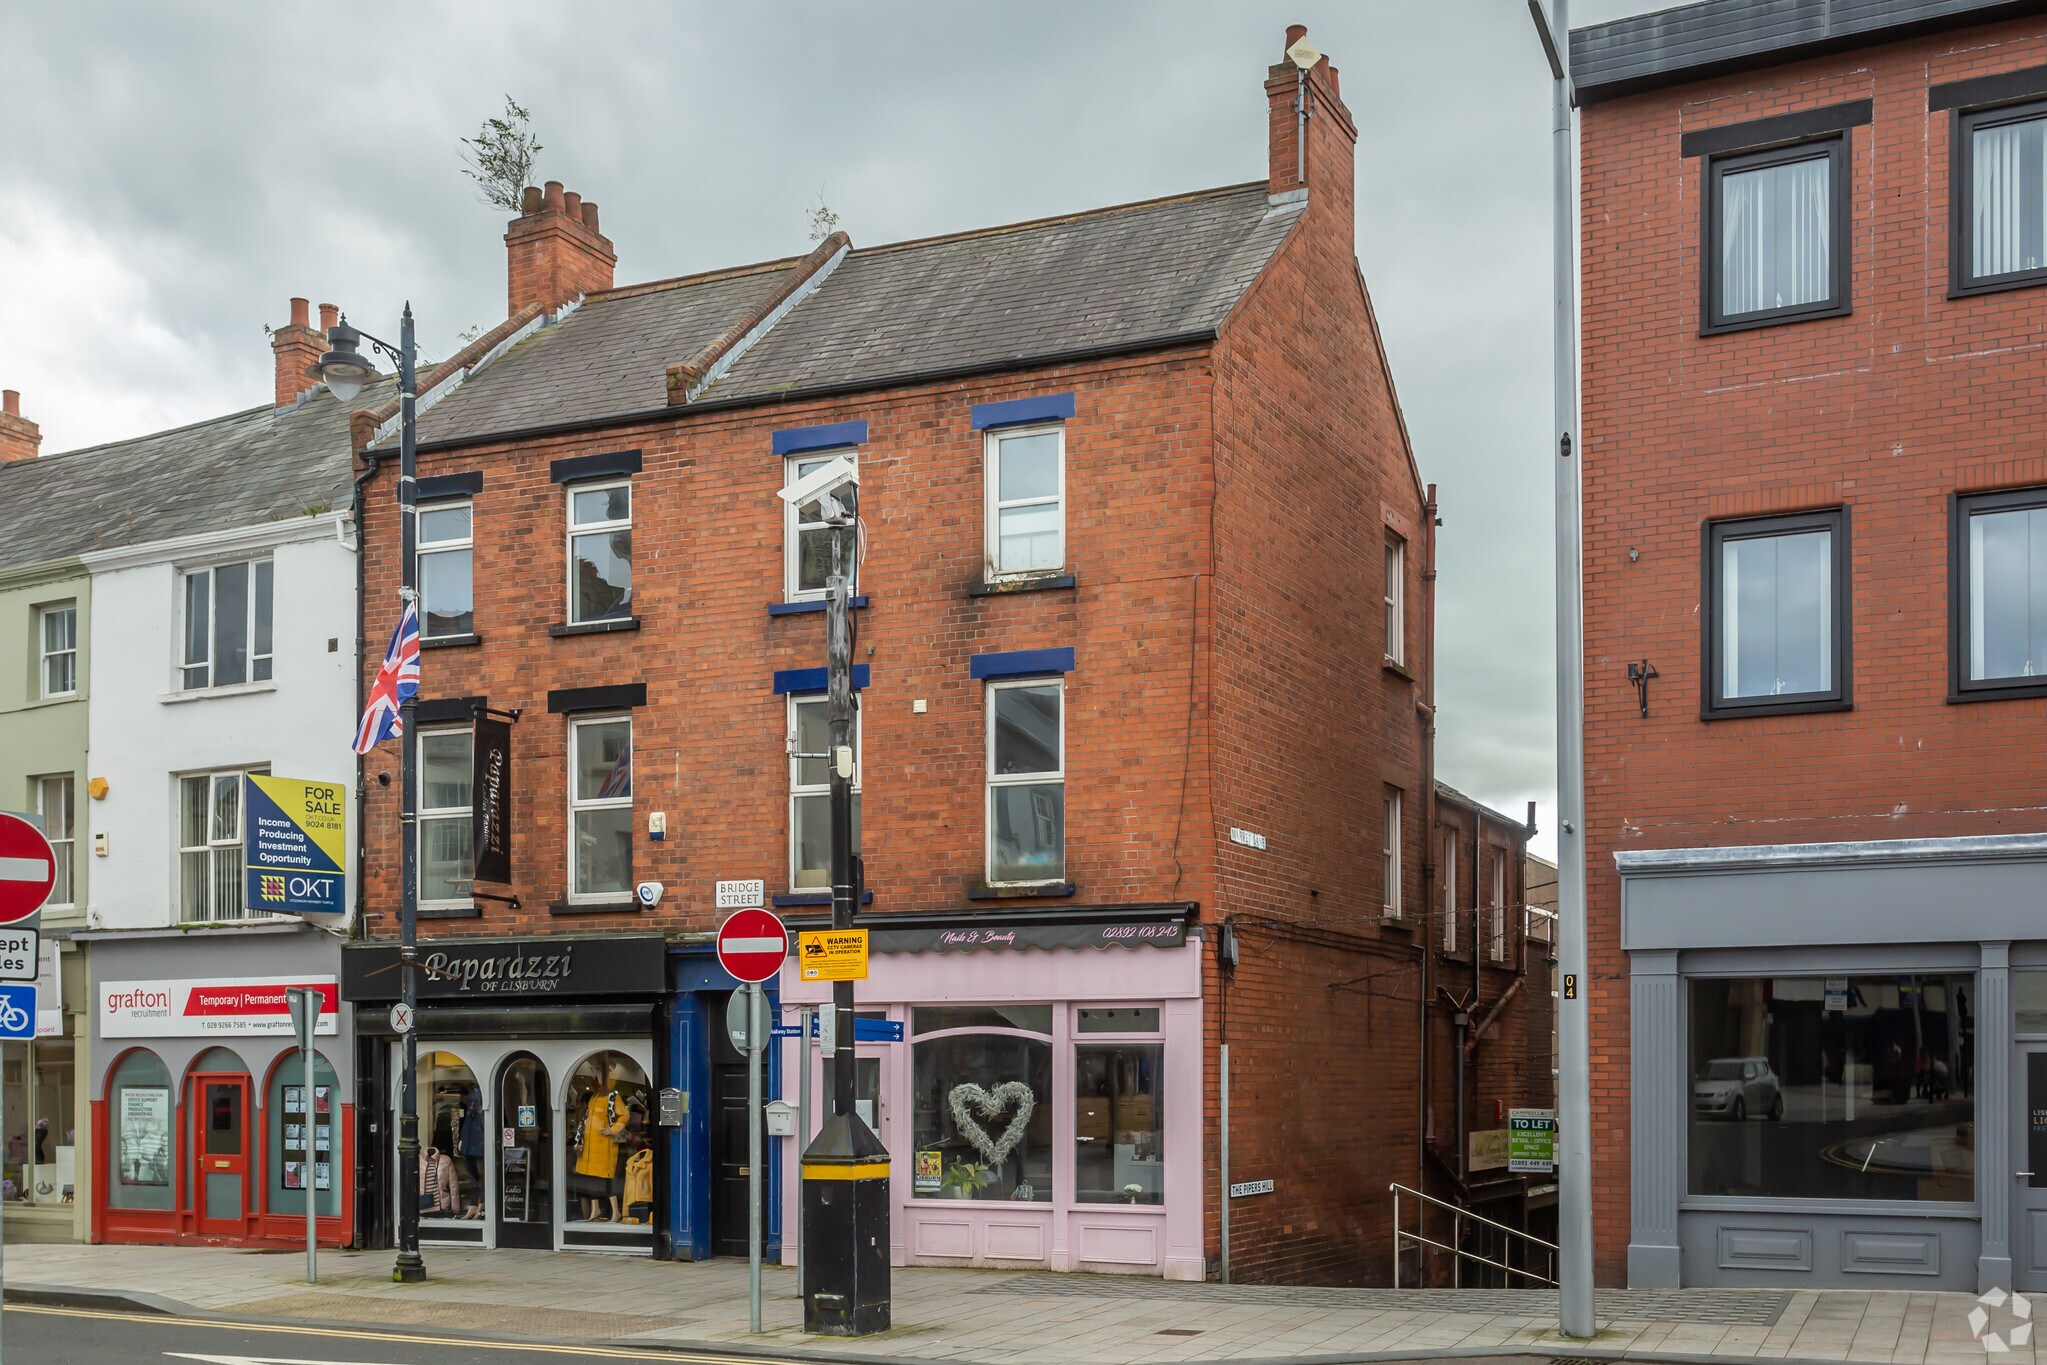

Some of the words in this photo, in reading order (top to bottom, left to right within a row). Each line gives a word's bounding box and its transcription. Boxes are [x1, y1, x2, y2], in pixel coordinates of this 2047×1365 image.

[305, 786, 334, 801] FOR
[305, 801, 341, 815] SALE
[258, 817, 291, 828] Income
[305, 821, 324, 829] 9024
[326, 822, 341, 830] 8181
[259, 829, 304, 842] Producing
[259, 841, 307, 852] Investment
[260, 852, 311, 866] Opportunity
[289, 877, 335, 898] OKT
[720, 882, 759, 893] BRIDGE
[721, 894, 759, 905] STREET
[940, 931, 966, 944] Nails
[981, 930, 1016, 945] Beauty
[1102, 926, 1137, 938] 02892
[1137, 926, 1156, 938] 108
[1155, 925, 1179, 937] 243
[425, 946, 572, 991] Paparazzi
[481, 981, 498, 991] OF
[500, 979, 559, 991] LISBURN
[108, 988, 168, 1013] grafton
[199, 994, 239, 1008] Temporary
[245, 993, 287, 1005] Permanent
[131, 1009, 168, 1018] recruitment
[1513, 1120, 1529, 1129] TO
[1531, 1120, 1550, 1129] LET
